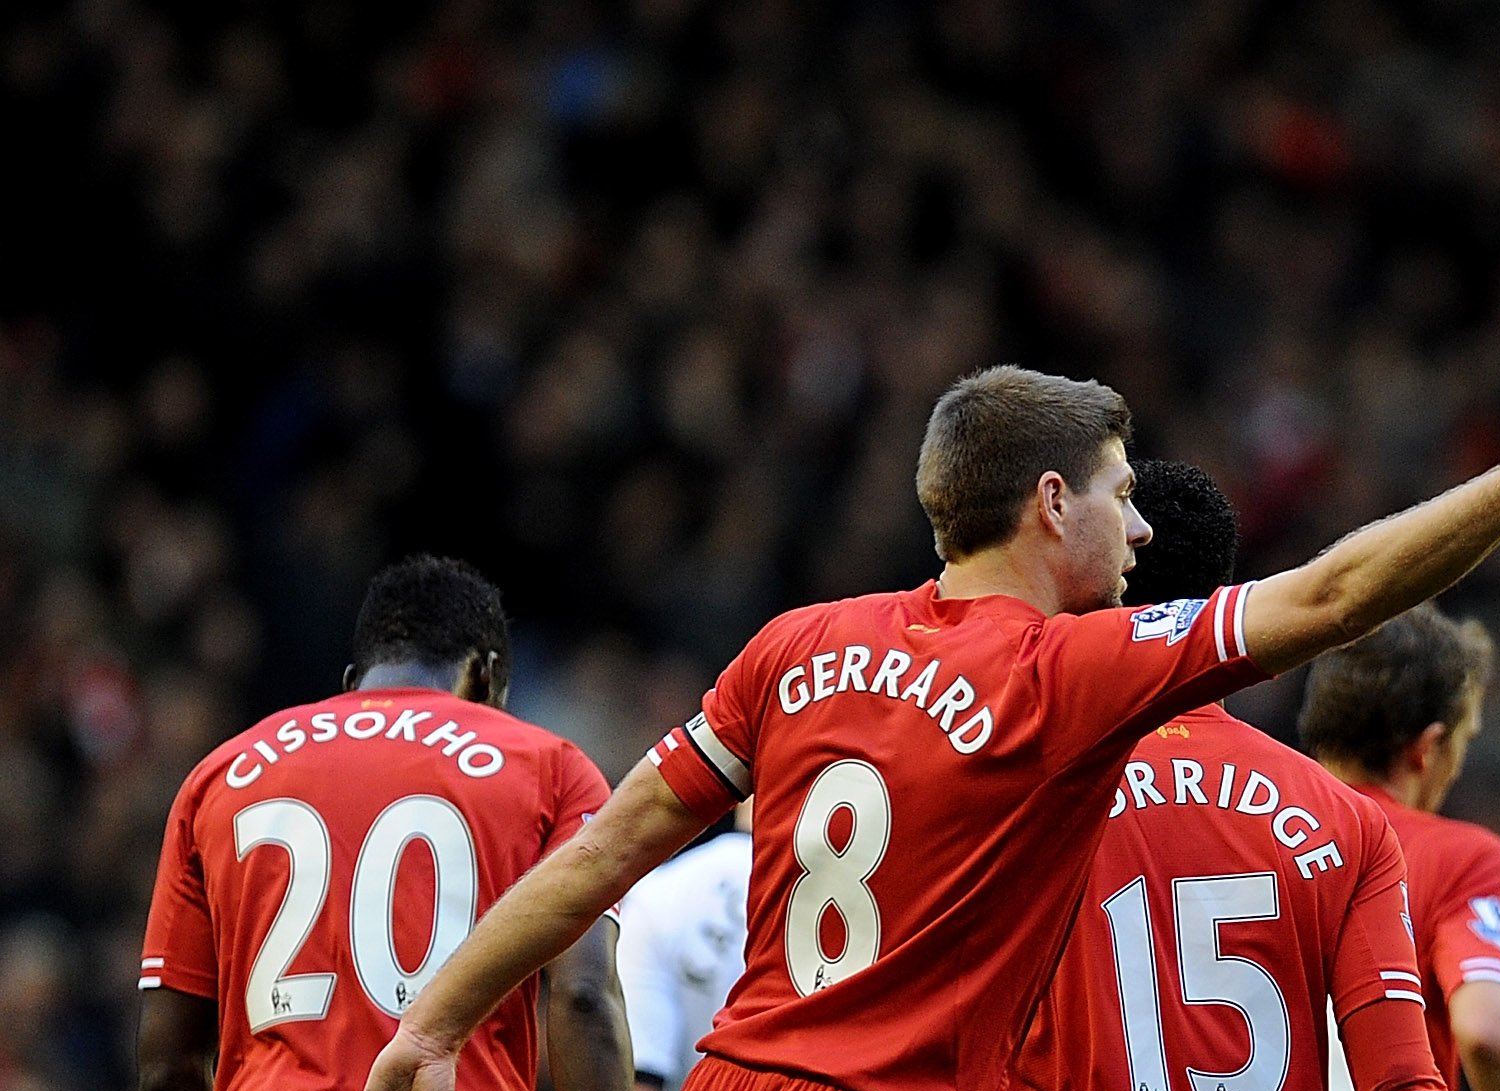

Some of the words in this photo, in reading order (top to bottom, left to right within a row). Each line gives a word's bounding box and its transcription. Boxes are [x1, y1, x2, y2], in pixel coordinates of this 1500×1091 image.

[224, 709, 505, 790] CISSOKHO
[777, 645, 994, 755] GERRARD
[785, 758, 892, 1000] 8
[1109, 758, 1345, 881] RRIDGE
[232, 794, 479, 1036] 20
